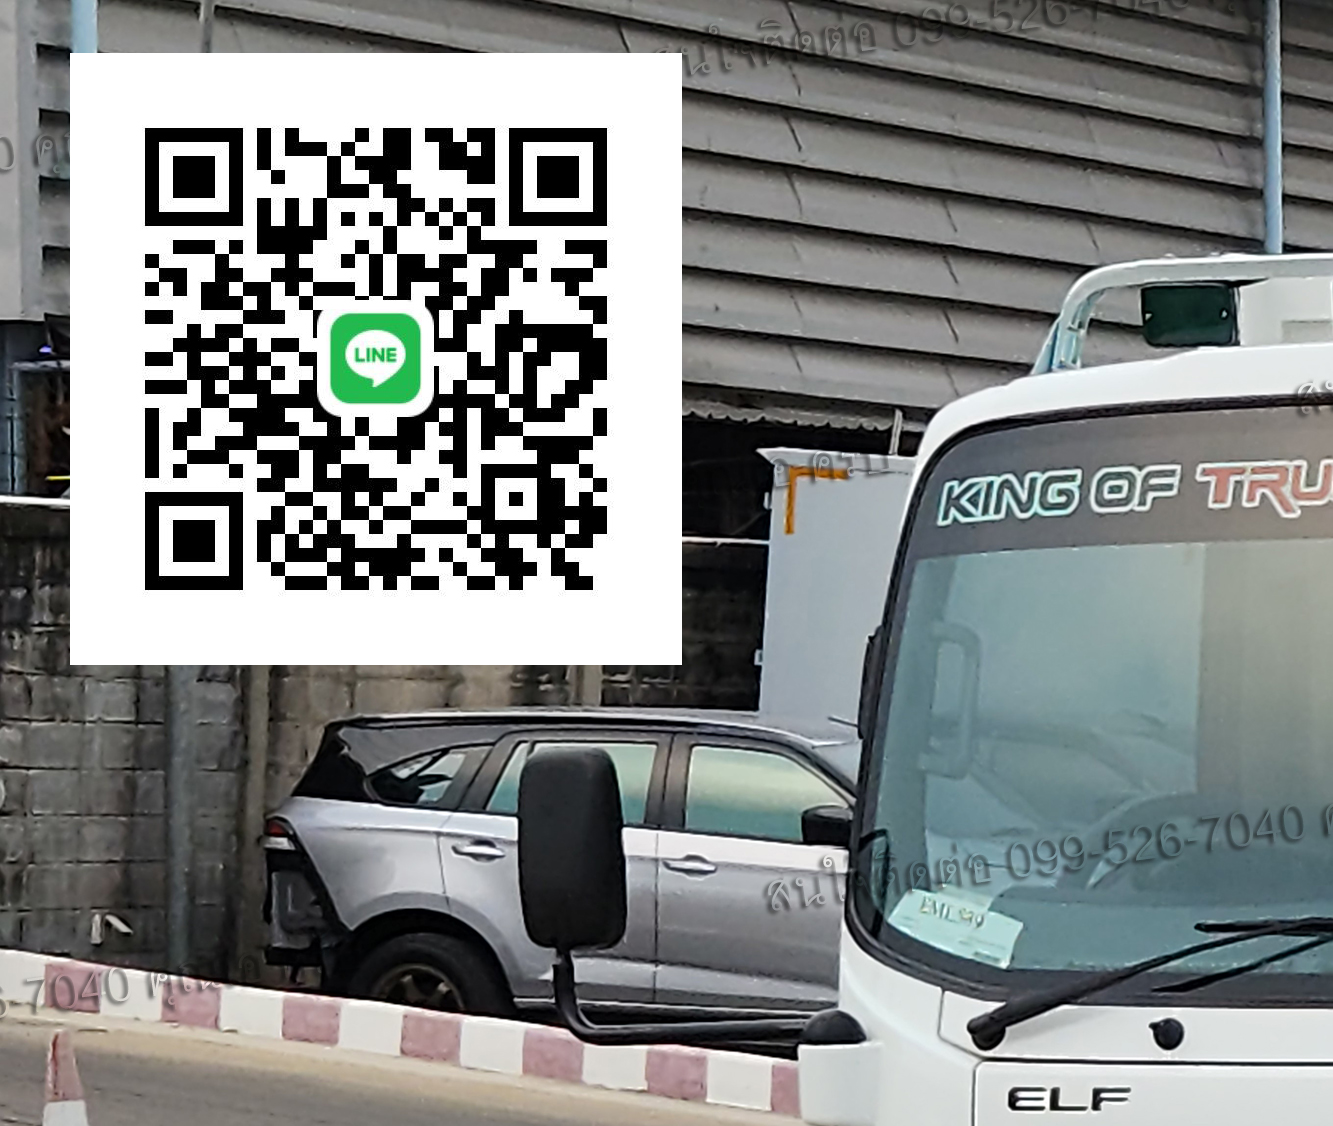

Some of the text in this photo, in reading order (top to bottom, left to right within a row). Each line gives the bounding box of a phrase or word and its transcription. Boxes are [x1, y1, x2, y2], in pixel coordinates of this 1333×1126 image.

[937, 468, 1082, 526] KING
[1091, 464, 1182, 514] OF
[1007, 1086, 1132, 1112] ELF
